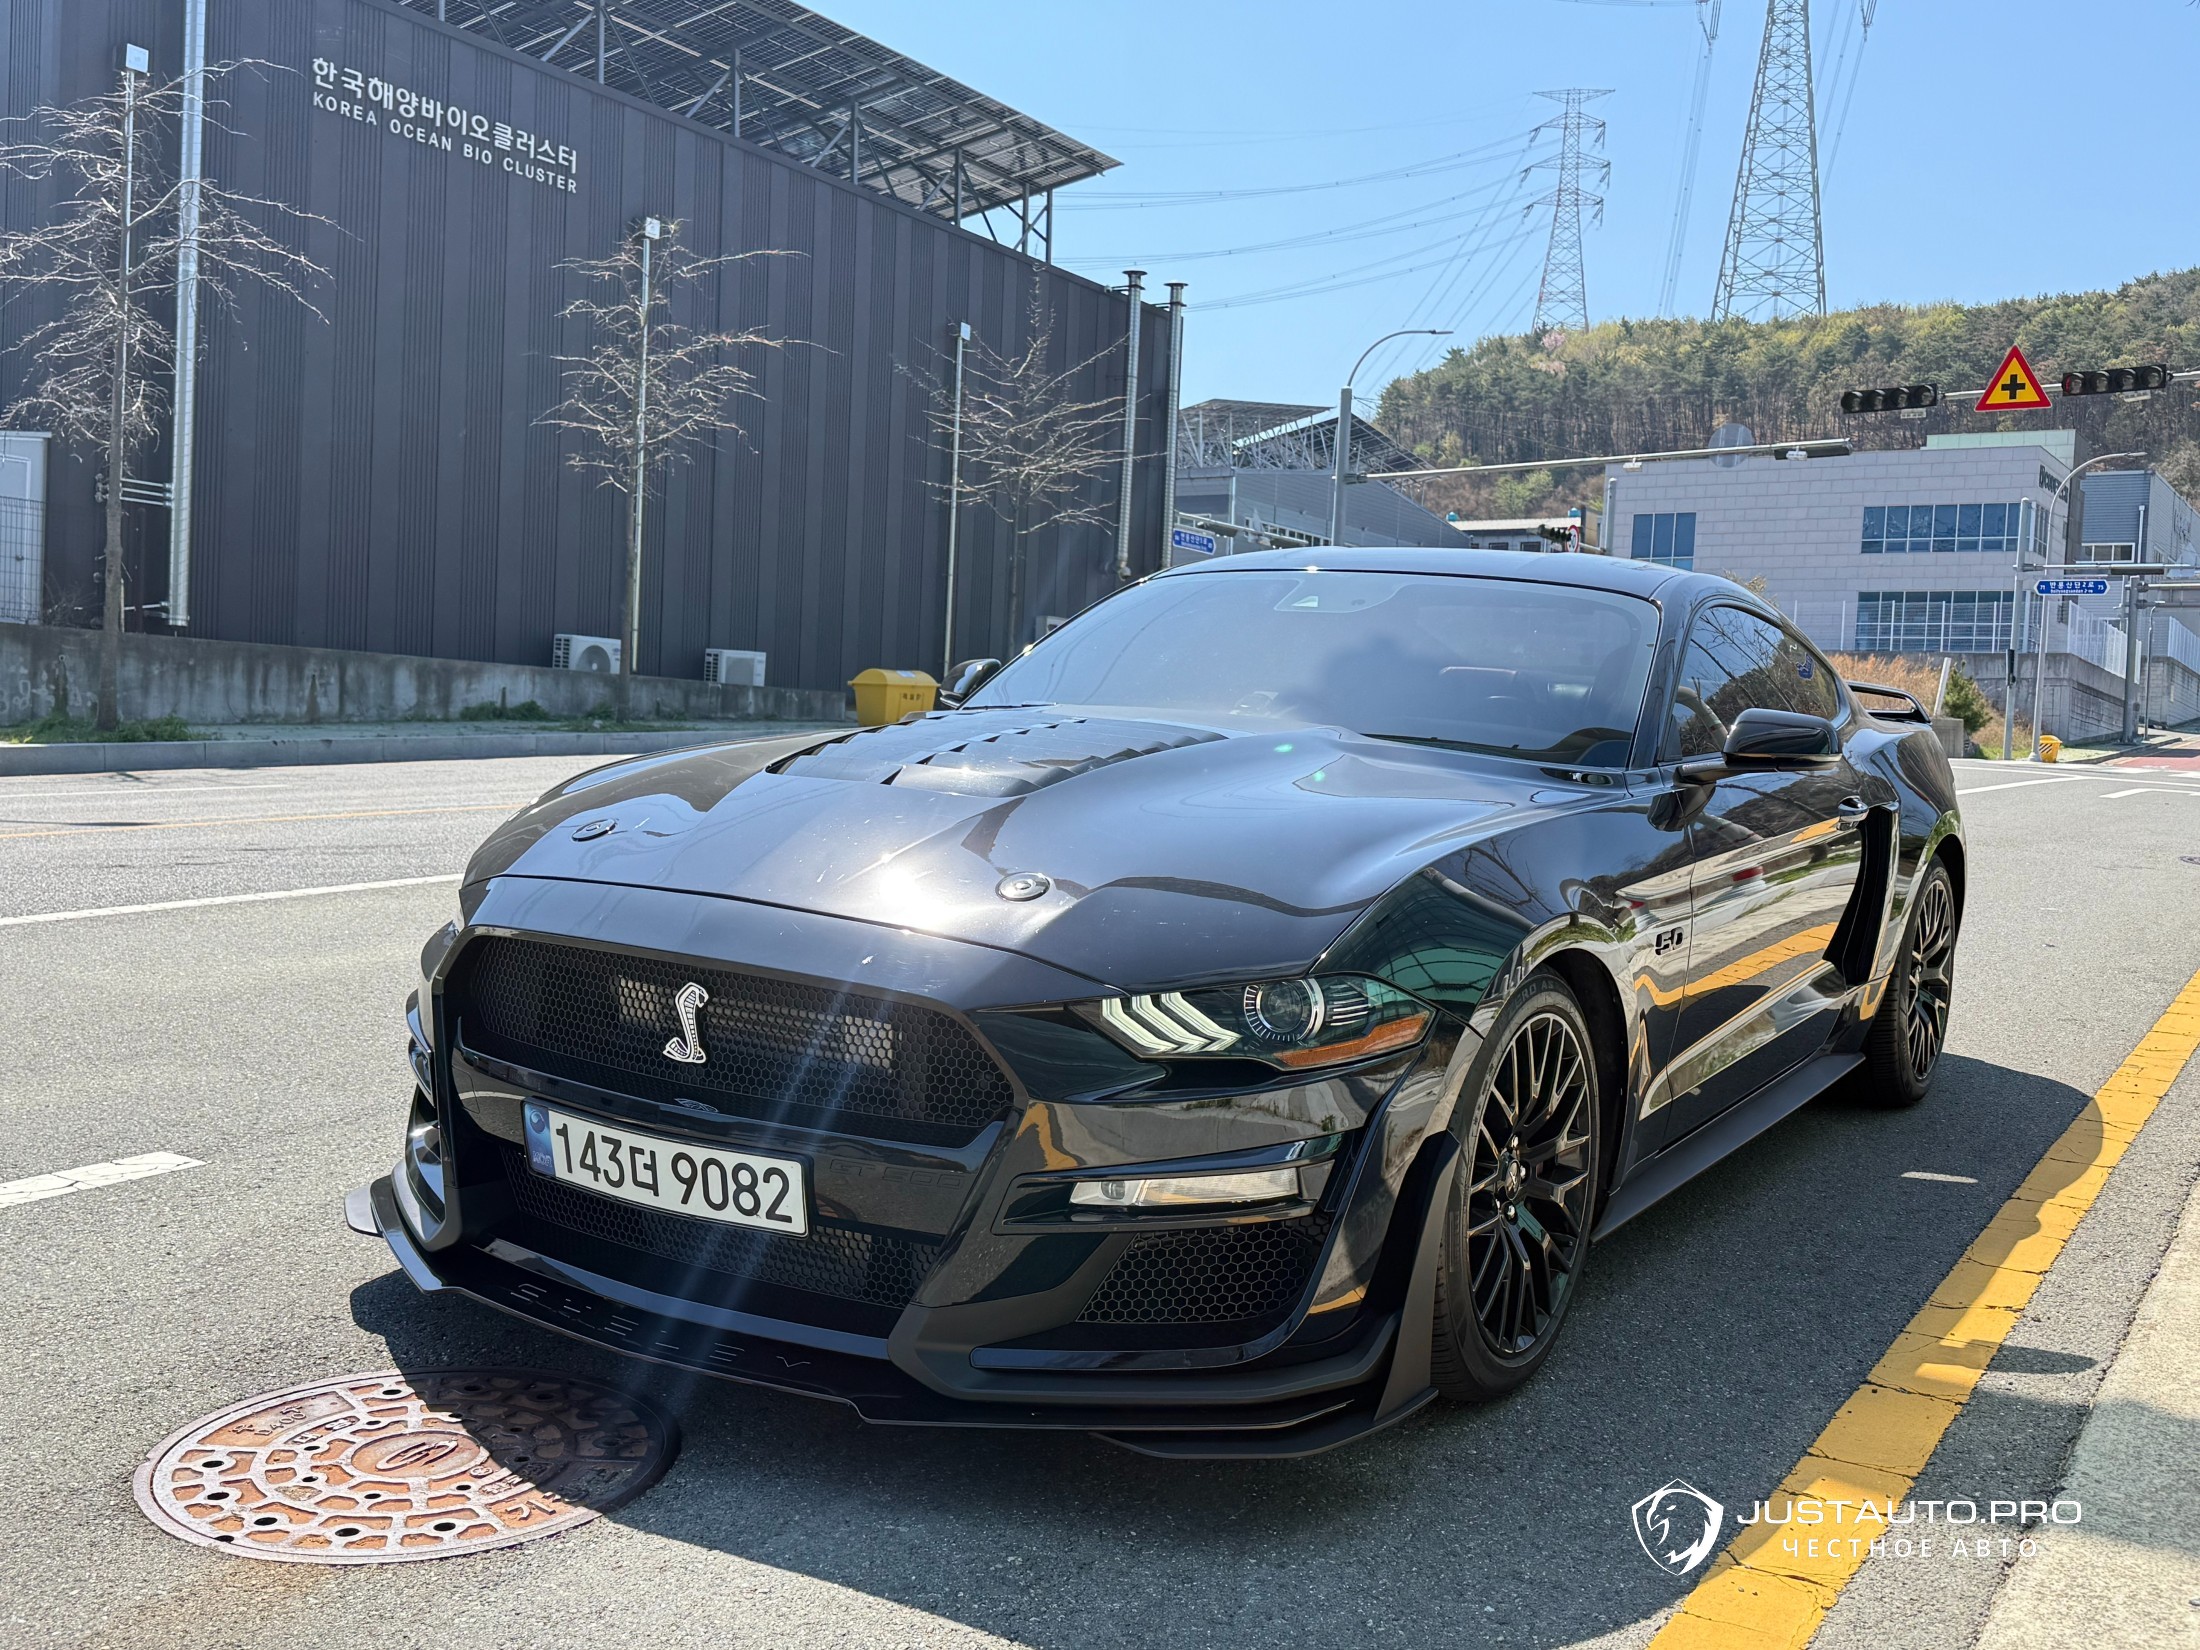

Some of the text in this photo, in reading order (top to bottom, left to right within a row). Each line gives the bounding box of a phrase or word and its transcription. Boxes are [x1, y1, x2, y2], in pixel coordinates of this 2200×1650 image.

[312, 57, 577, 174] 한국해양바이오클러스터
[313, 91, 577, 194] KOREA OCEAN BIO CLUSTER
[556, 1122, 793, 1224] 143더 9082
[254, 1413, 307, 1436] D400
